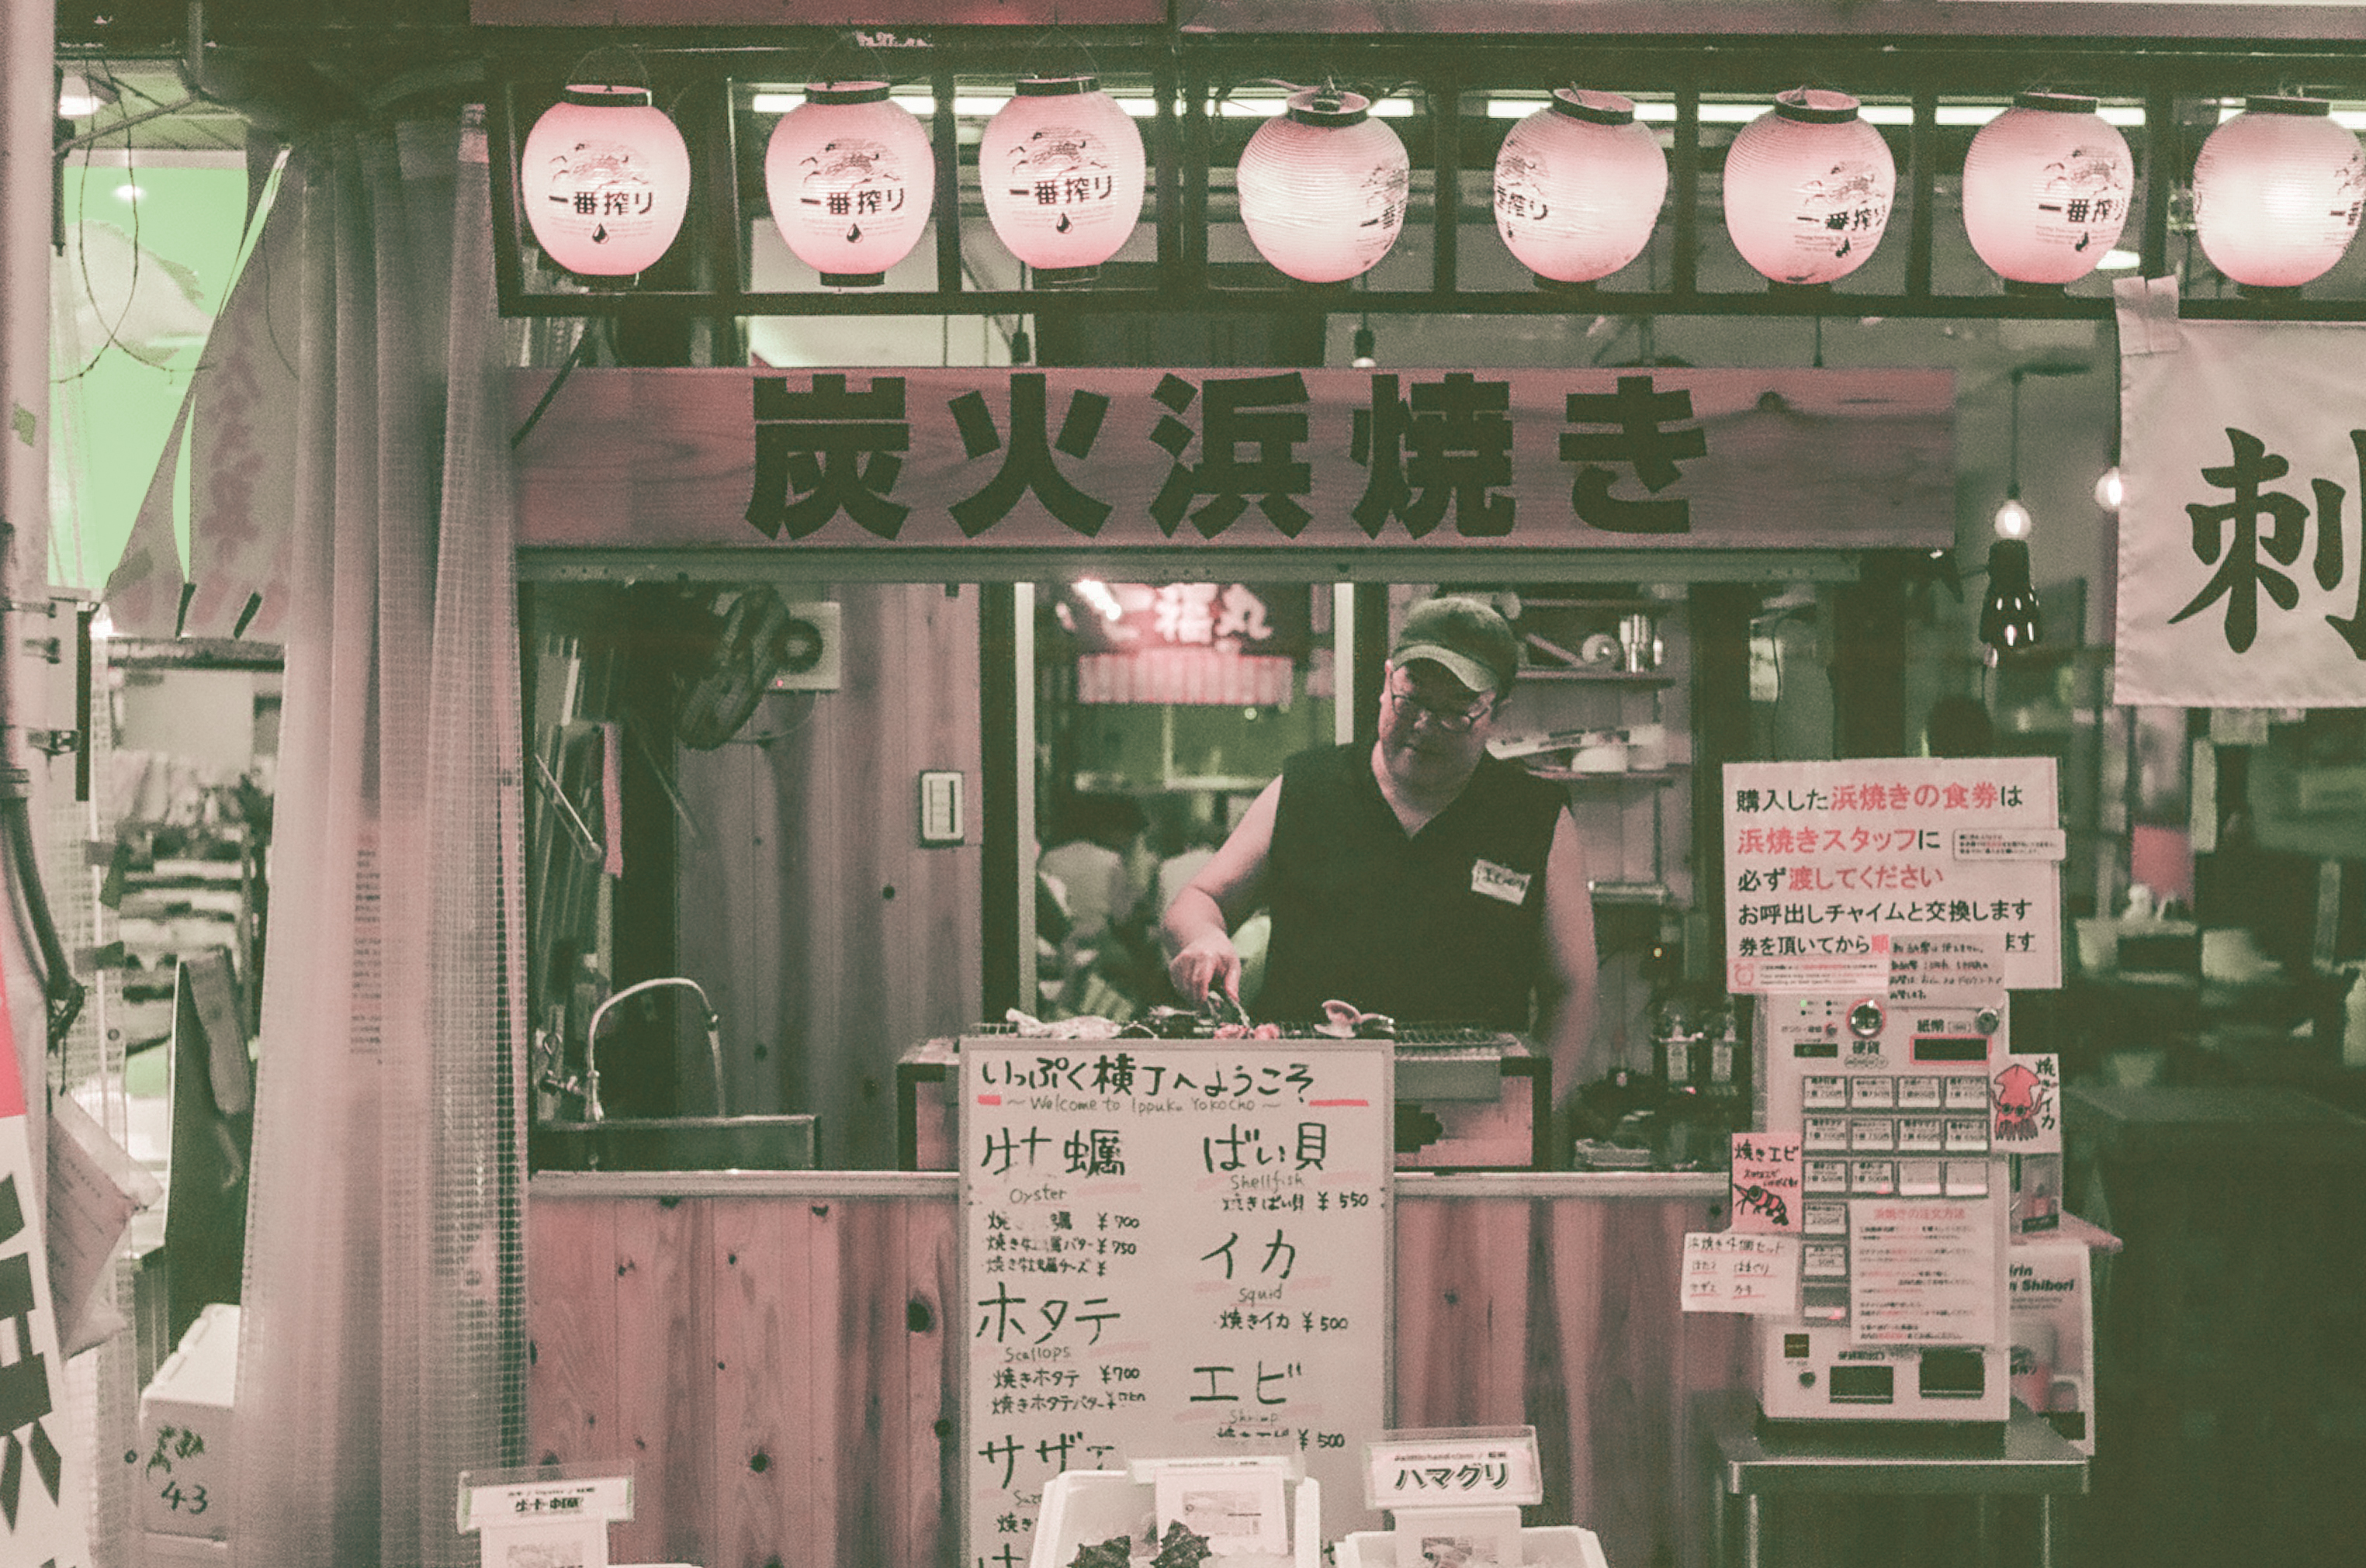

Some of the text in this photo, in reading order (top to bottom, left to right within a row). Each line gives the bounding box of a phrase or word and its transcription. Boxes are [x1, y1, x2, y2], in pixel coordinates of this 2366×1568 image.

[549, 192, 653, 216] 一番搾り
[800, 188, 906, 216] 一番搾り
[1009, 175, 1114, 206] 一番搾り
[743, 372, 1707, 542] 炭火浜焼き
[1737, 781, 2023, 813] 購入した浜焼きの食券は
[1737, 826, 1941, 854] 浜焼きスタッフに
[1737, 864, 1944, 892] 必ず渡してください
[1738, 898, 2032, 925] お呼出しチャイムと交換します
[982, 1053, 1315, 1102] いっぷく横丁へようこそ
[1031, 1095, 1097, 1112] Welcome
[1104, 1099, 1121, 1112] to
[1204, 1122, 1326, 1173] ばい貝
[1734, 1138, 1799, 1163] 焼きエビ
[1010, 1183, 1067, 1203] Oyster
[1231, 1170, 1306, 1193] Shellfish
[976, 1229, 1296, 1345] ホタテ イカ
[1238, 1284, 1283, 1305] Squid
[1219, 1311, 1290, 1331] 焼きイカ
[1005, 1347, 1071, 1363] Scallops
[993, 1366, 1080, 1389] 焼きホタテ
[1190, 1361, 1302, 1405] エビ
[1394, 1463, 1509, 1490] ハマグリ
[161, 1481, 208, 1514] 43
